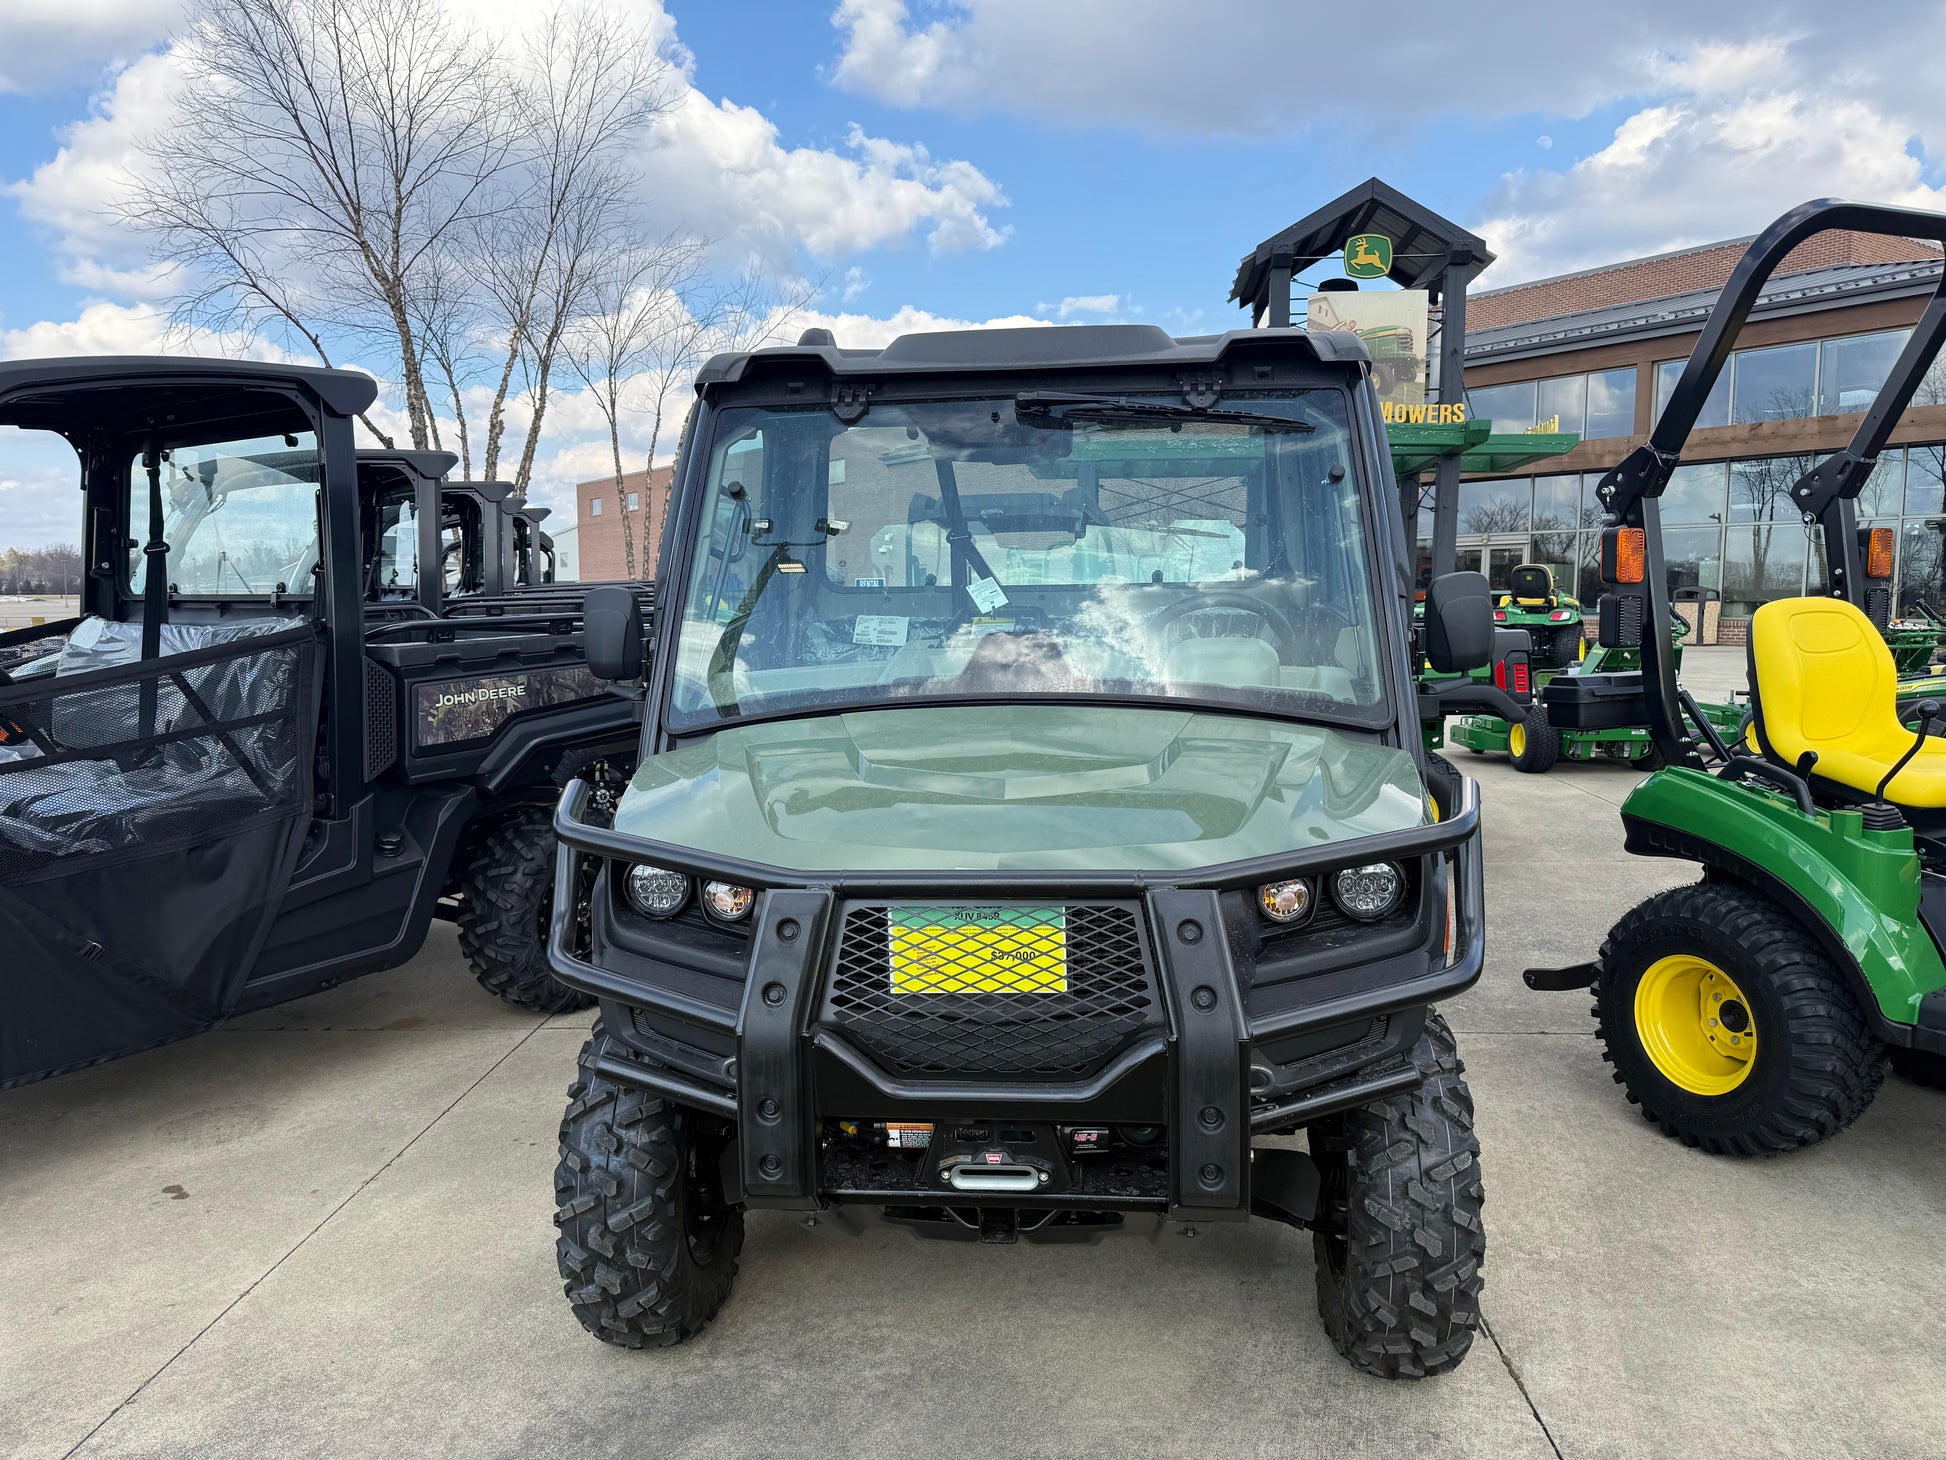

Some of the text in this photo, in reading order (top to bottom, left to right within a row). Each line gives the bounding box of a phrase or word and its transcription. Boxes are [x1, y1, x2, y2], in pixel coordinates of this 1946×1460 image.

[1379, 401, 1466, 424] MOWERS
[435, 685, 526, 708] JOHN DEERE
[953, 911, 974, 921] XUV
[990, 950, 1036, 962] $37,000
